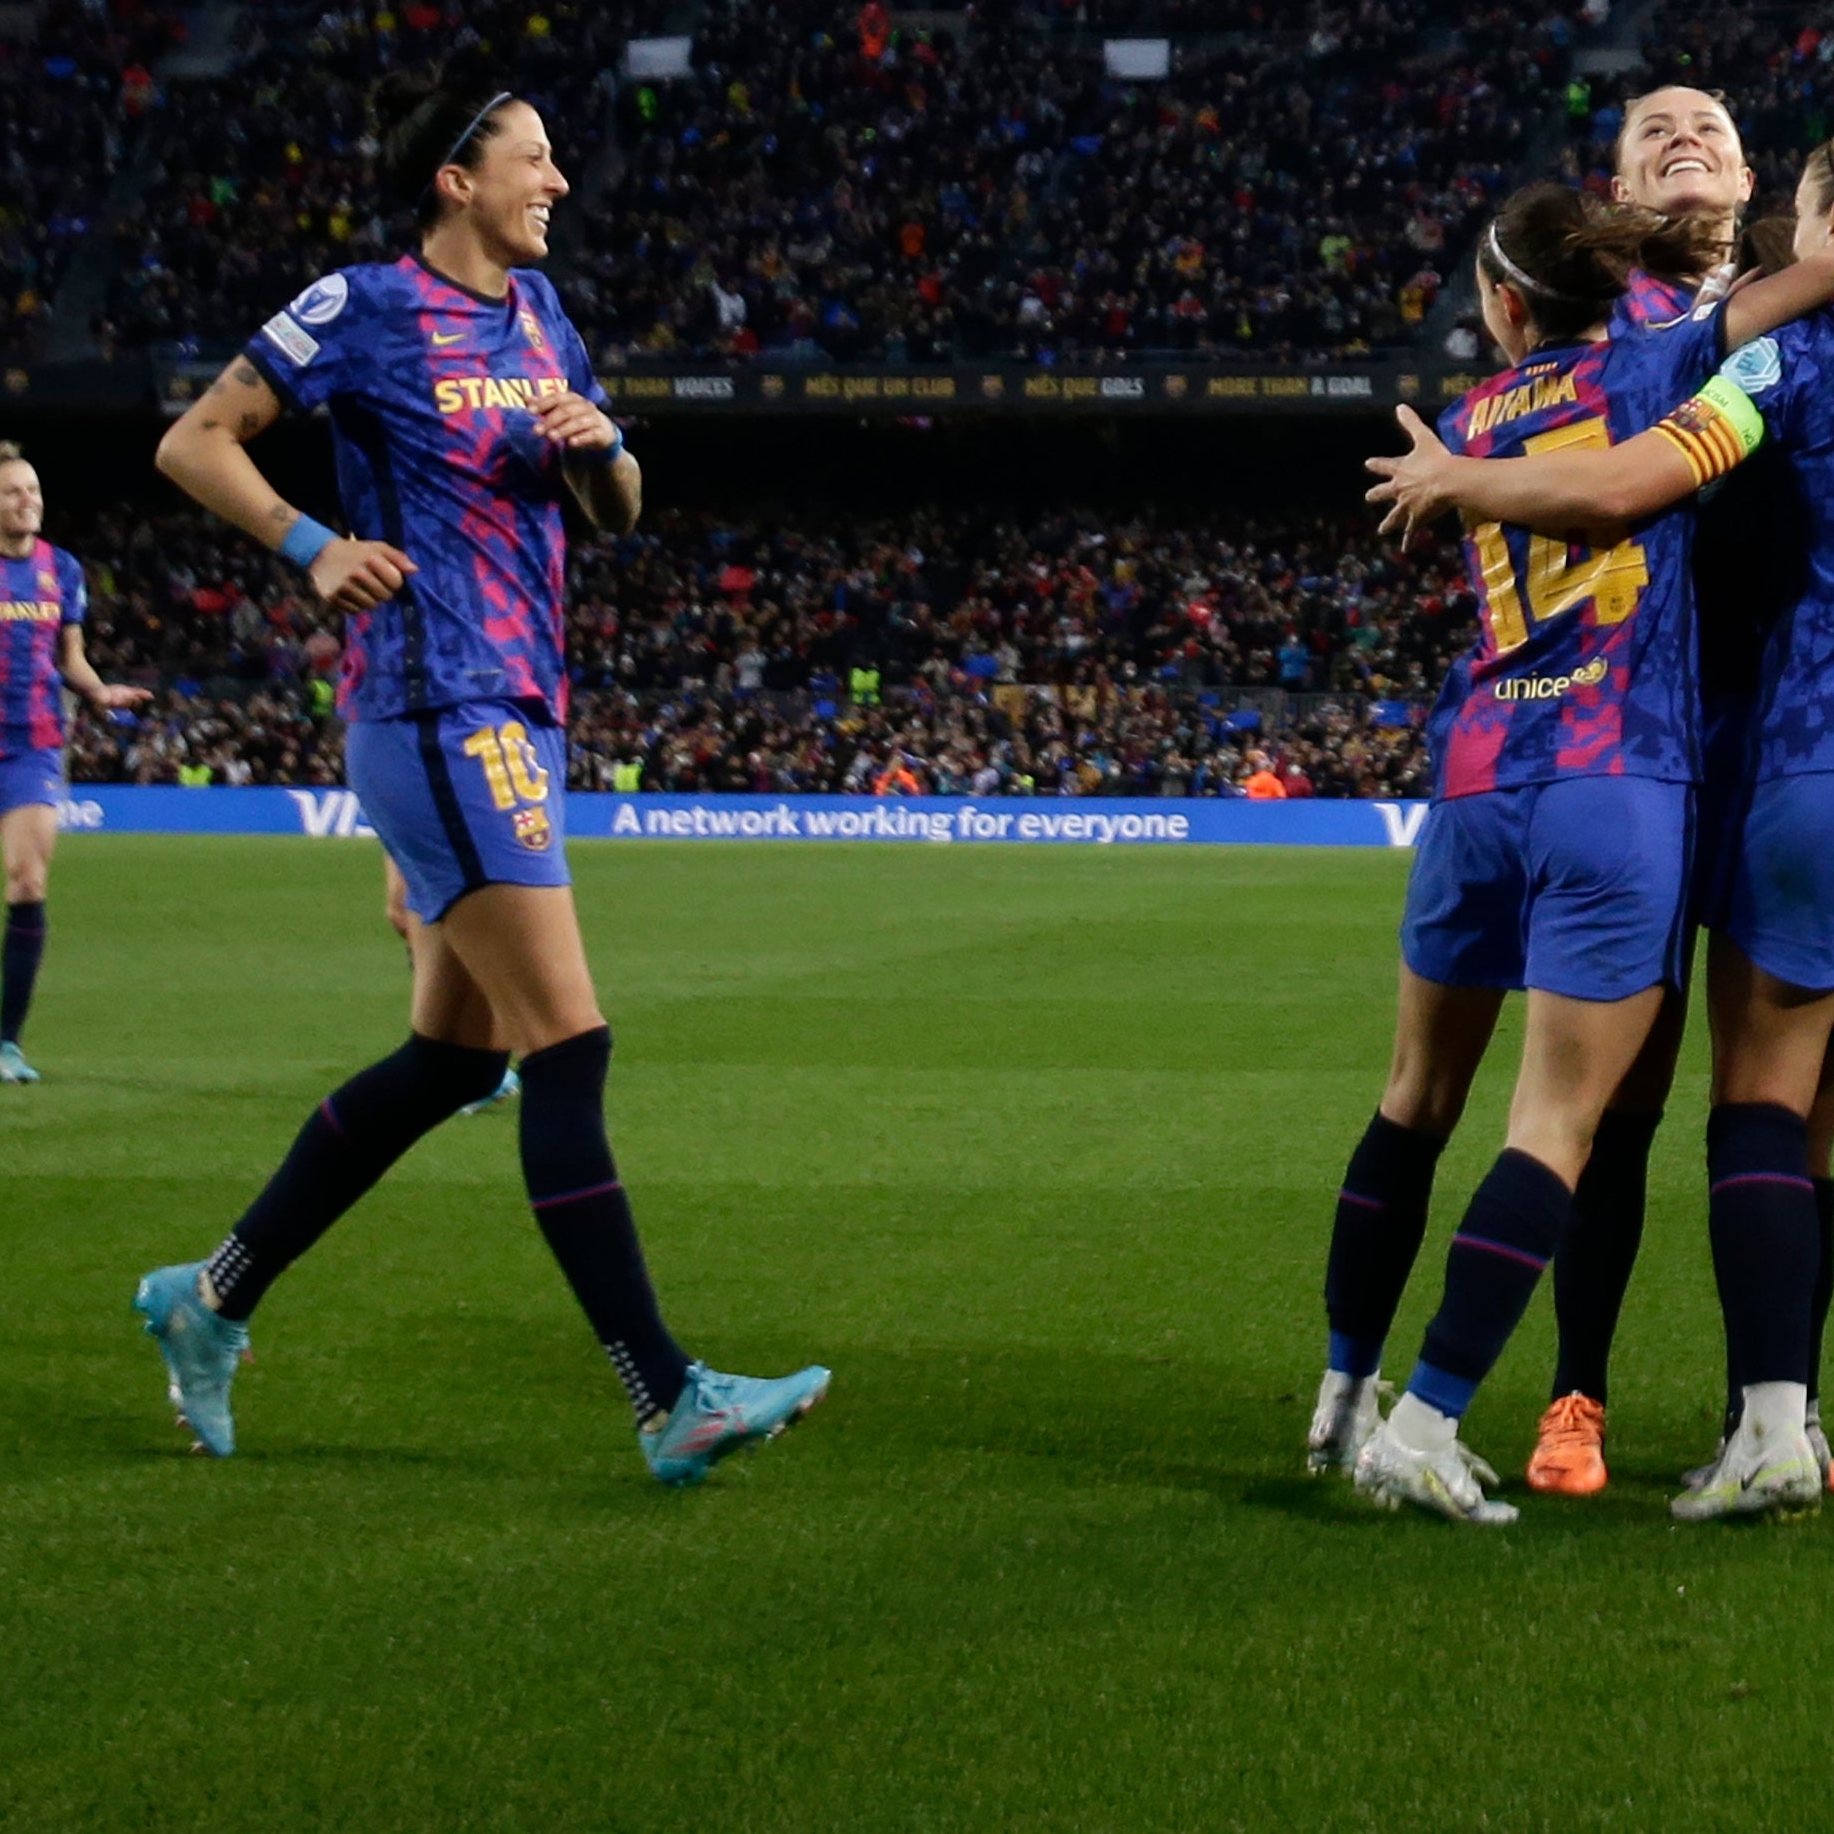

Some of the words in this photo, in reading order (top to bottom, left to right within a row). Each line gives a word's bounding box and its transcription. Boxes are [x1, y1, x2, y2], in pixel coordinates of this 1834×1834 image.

[1461, 416, 1650, 654] 14
[1495, 671, 1570, 700] unice
[286, 790, 379, 837] VI
[613, 802, 642, 835] A
[647, 803, 801, 836] network
[804, 803, 954, 843] working
[958, 805, 1014, 838] for
[1017, 812, 1189, 844] everyone
